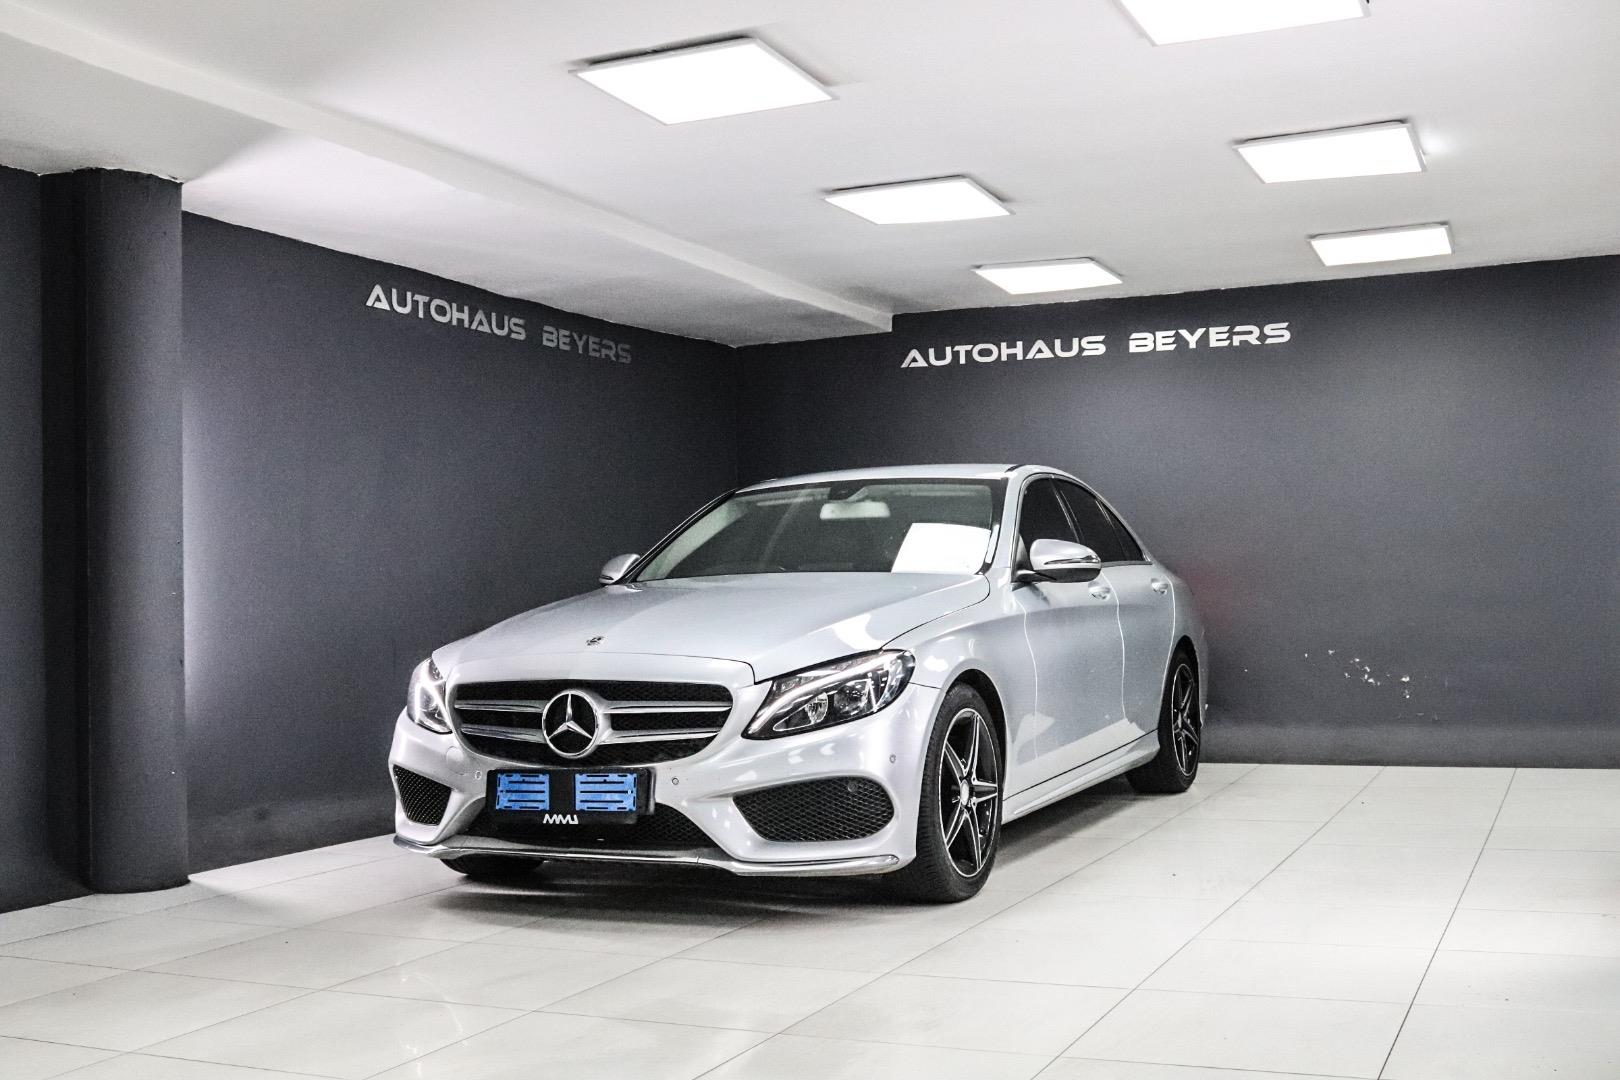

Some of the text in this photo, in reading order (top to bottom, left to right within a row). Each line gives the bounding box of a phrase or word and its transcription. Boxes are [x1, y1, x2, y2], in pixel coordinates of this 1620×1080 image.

[366, 284, 632, 364] AUTOHAUS BEYERS
[901, 322, 1291, 368] AUTOHAUS BEYERS
